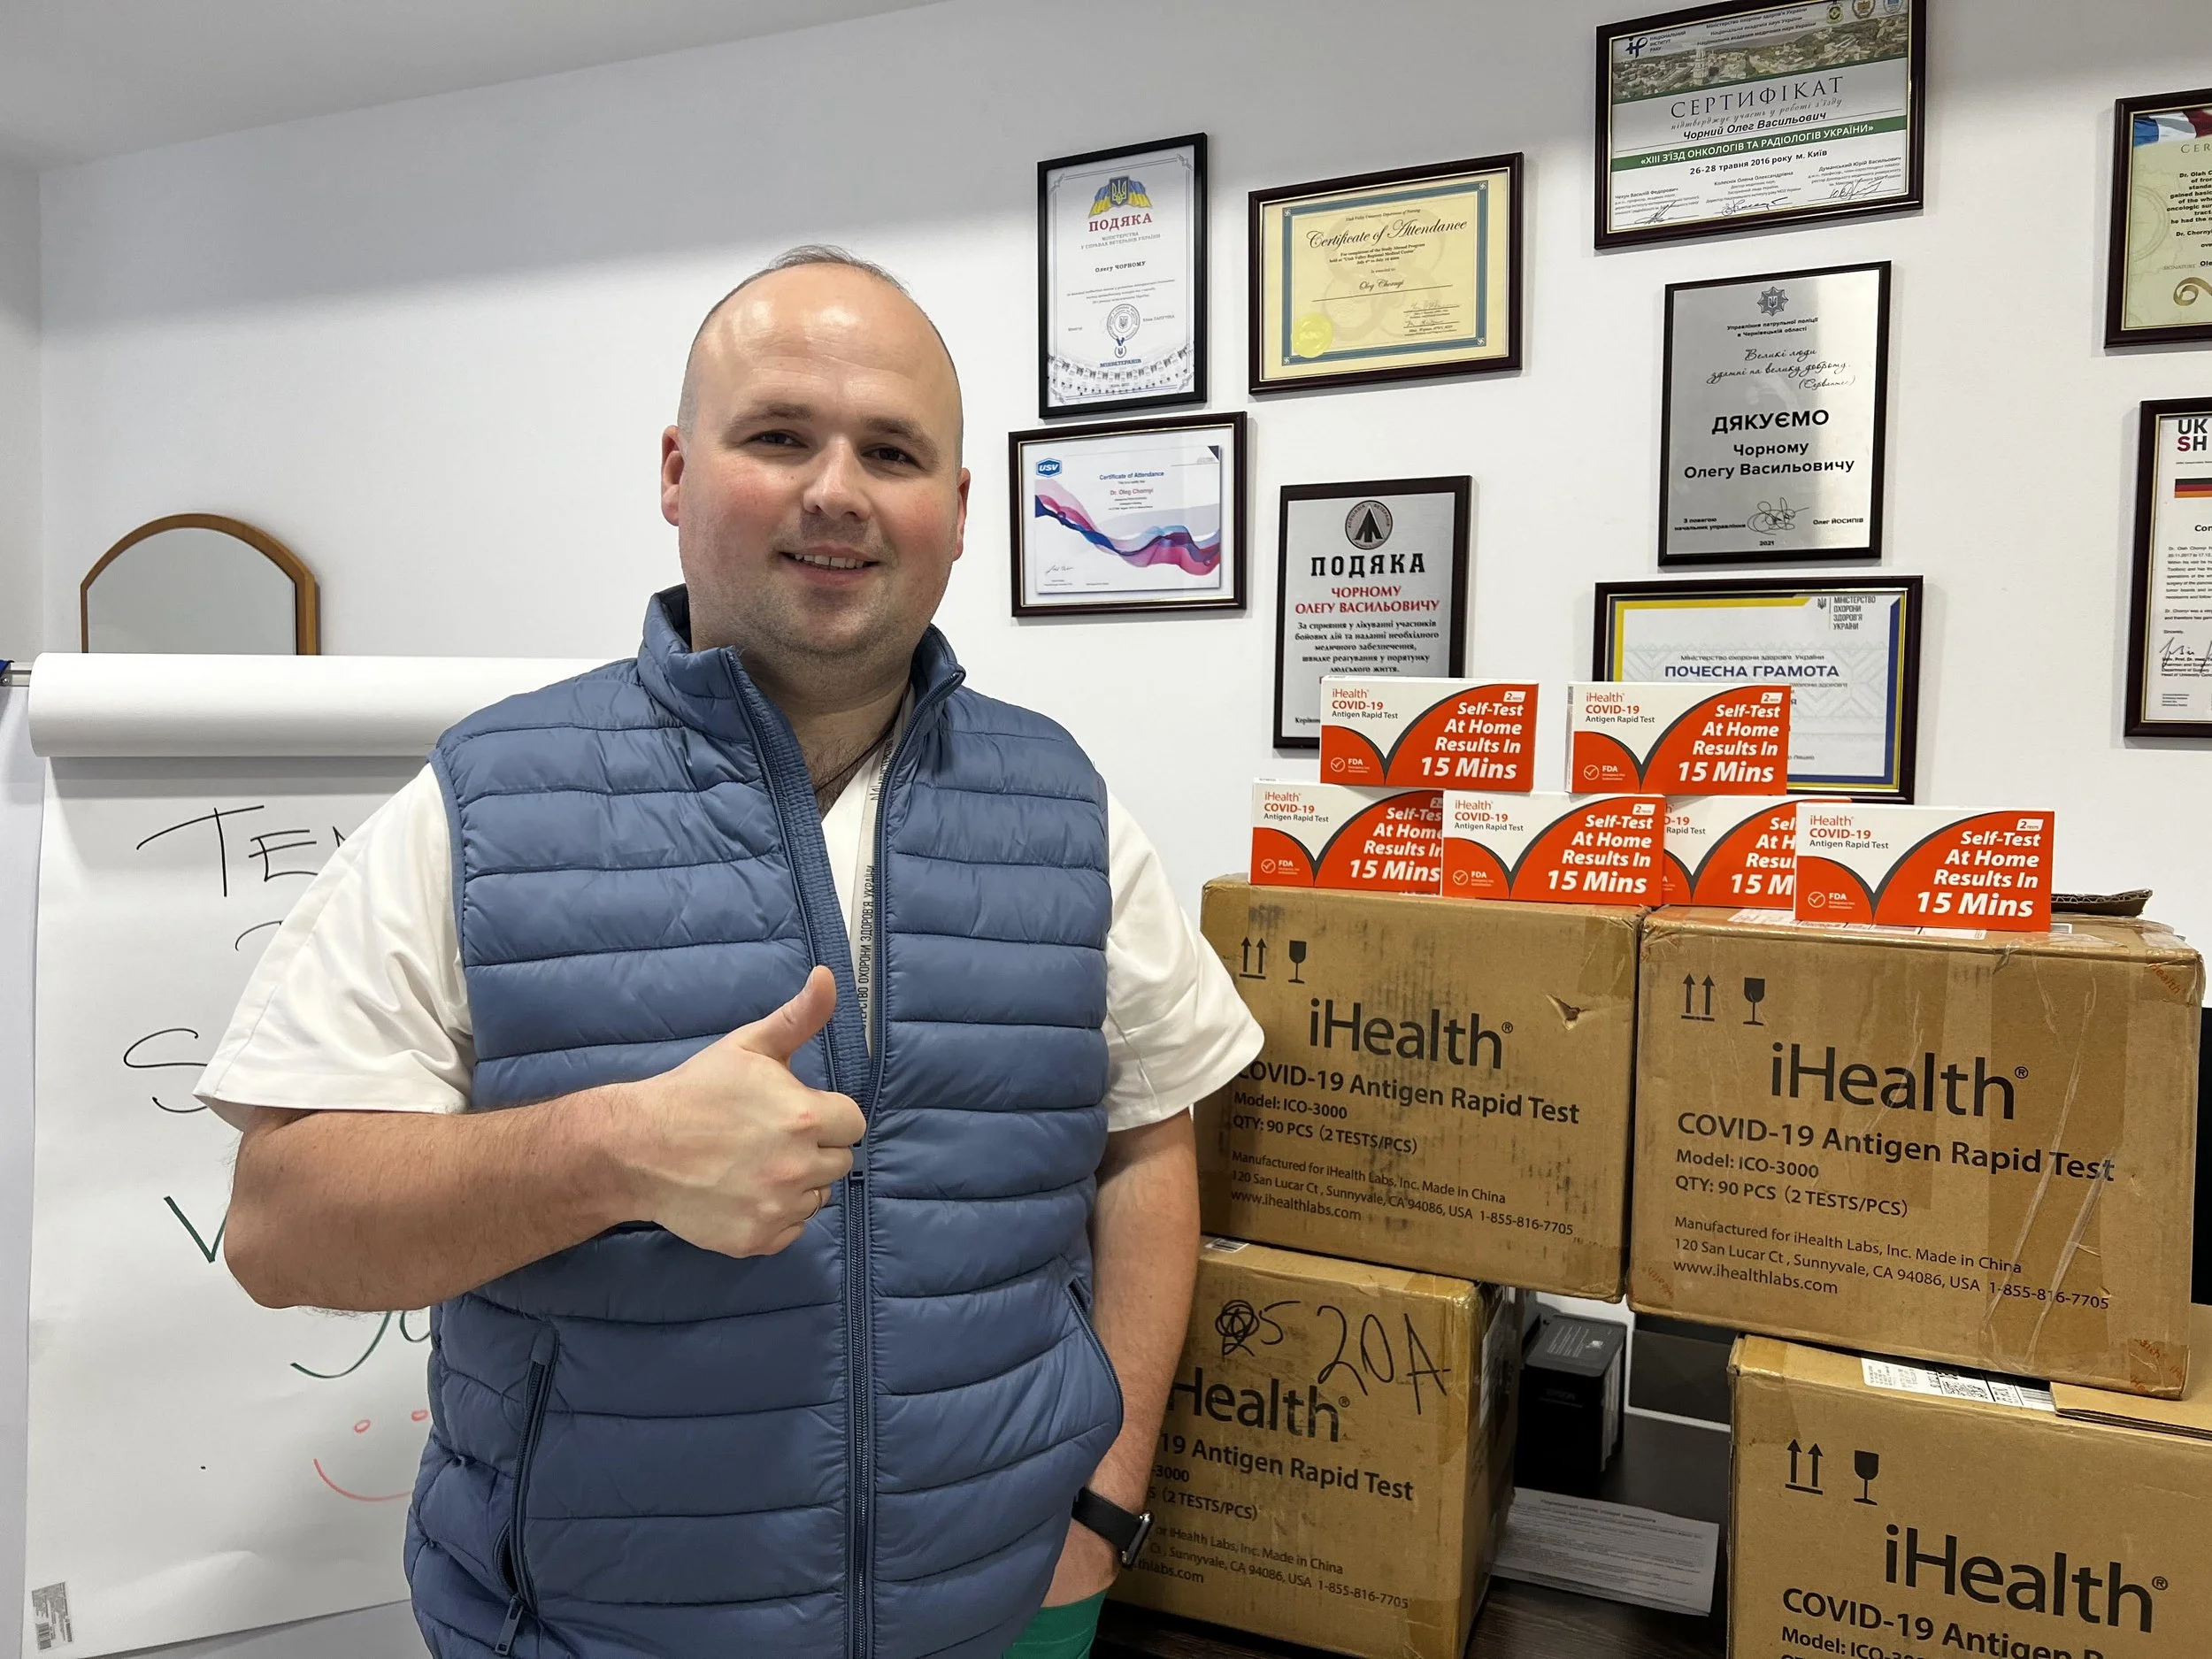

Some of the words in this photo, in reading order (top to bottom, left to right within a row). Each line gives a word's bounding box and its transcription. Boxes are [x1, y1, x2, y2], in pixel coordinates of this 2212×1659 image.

[1671, 76, 1842, 118] СЕРТИФІКАТ
[1684, 126, 1723, 139] Чорний
[1727, 123, 1754, 133] Олег
[1757, 112, 1826, 128] Васильович
[1687, 142, 1744, 157] ОНКОЛОГІВ
[1761, 131, 1821, 147] РАДІОЛОГІВ
[1824, 124, 1873, 138] УКРАЇНИ»
[1690, 165, 1716, 174] 26-28
[1719, 161, 1747, 172] травня
[1750, 157, 1769, 165] 2016
[1771, 155, 1792, 165] року
[1089, 213, 1151, 231] ПОДЯКА
[1306, 230, 1371, 250] Certificate
[1372, 225, 1388, 246] of
[1386, 219, 1467, 239] Attendance
[1745, 349, 1786, 361] Великі
[1789, 349, 1817, 362] люди
[1765, 363, 1801, 378] велику
[1712, 410, 1828, 434] ДЯКУЄМО
[2177, 419, 2208, 435] UK
[1733, 442, 1809, 457] Чорному
[2177, 436, 2208, 452] SH
[1685, 466, 1734, 479] Олегу
[1740, 460, 1854, 475] Васильовичу
[1311, 553, 1425, 577] ПОДЯКА
[1332, 586, 1401, 597] ЧОРНОМУ
[1295, 603, 1335, 613] ОЛЕГУ
[1340, 600, 1439, 612] ВАСИЛЬОВИЧУ
[1356, 620, 1393, 629] лікуванні
[1395, 619, 1436, 628] учасників
[1665, 665, 1747, 677] ПОЧЕСНА
[1753, 665, 1839, 676] ГРАМОТА
[1332, 701, 1383, 710] COVID-19
[1457, 702, 1523, 716] Self-Test
[1444, 718, 1465, 733] At
[1469, 719, 1521, 734] Home
[1435, 736, 1499, 752] Results
[1503, 739, 1520, 753] In
[1422, 757, 1450, 776] 15
[1455, 757, 1517, 779] Mins
[1809, 828, 1870, 839] COVID-19
[1960, 831, 2040, 846] Self-Test
[1809, 840, 1842, 849] Antigen
[1945, 849, 1970, 864] At
[1974, 849, 2039, 867] Home
[1933, 869, 2011, 887] Results
[2016, 872, 2038, 887] In
[1917, 891, 1952, 913] 15
[1958, 893, 2032, 917] Mins
[861, 901, 874, 941] ЗДОРОВ'Я
[858, 945, 872, 983] ОХОРОНИ
[1678, 1112, 1813, 1146] COVID-19
[1822, 1127, 1939, 1163] Antigen
[1952, 1141, 2040, 1174] Rapid
[2048, 1149, 2114, 1183] Test
[1675, 1148, 1733, 1168] Model:
[1739, 1156, 1818, 1178] ICO-3000
[1676, 1175, 1713, 1192] QTY:
[1718, 1180, 1738, 1194] 90
[1744, 1183, 1775, 1200] PCS
[1675, 1238, 1698, 1251] 120
[1701, 1240, 1724, 1255] San
[1729, 1244, 1765, 1262] Lucar
[1793, 1253, 1869, 1276] Sunnyvale,
[1872, 1264, 1893, 1279] CA
[1897, 1267, 1945, 1288] 94086,
[1949, 1275, 1980, 1292] USA
[1673, 1261, 1837, 1294] www.ihealthlabs.com
[1783, 1587, 1934, 1641] COVID-19
